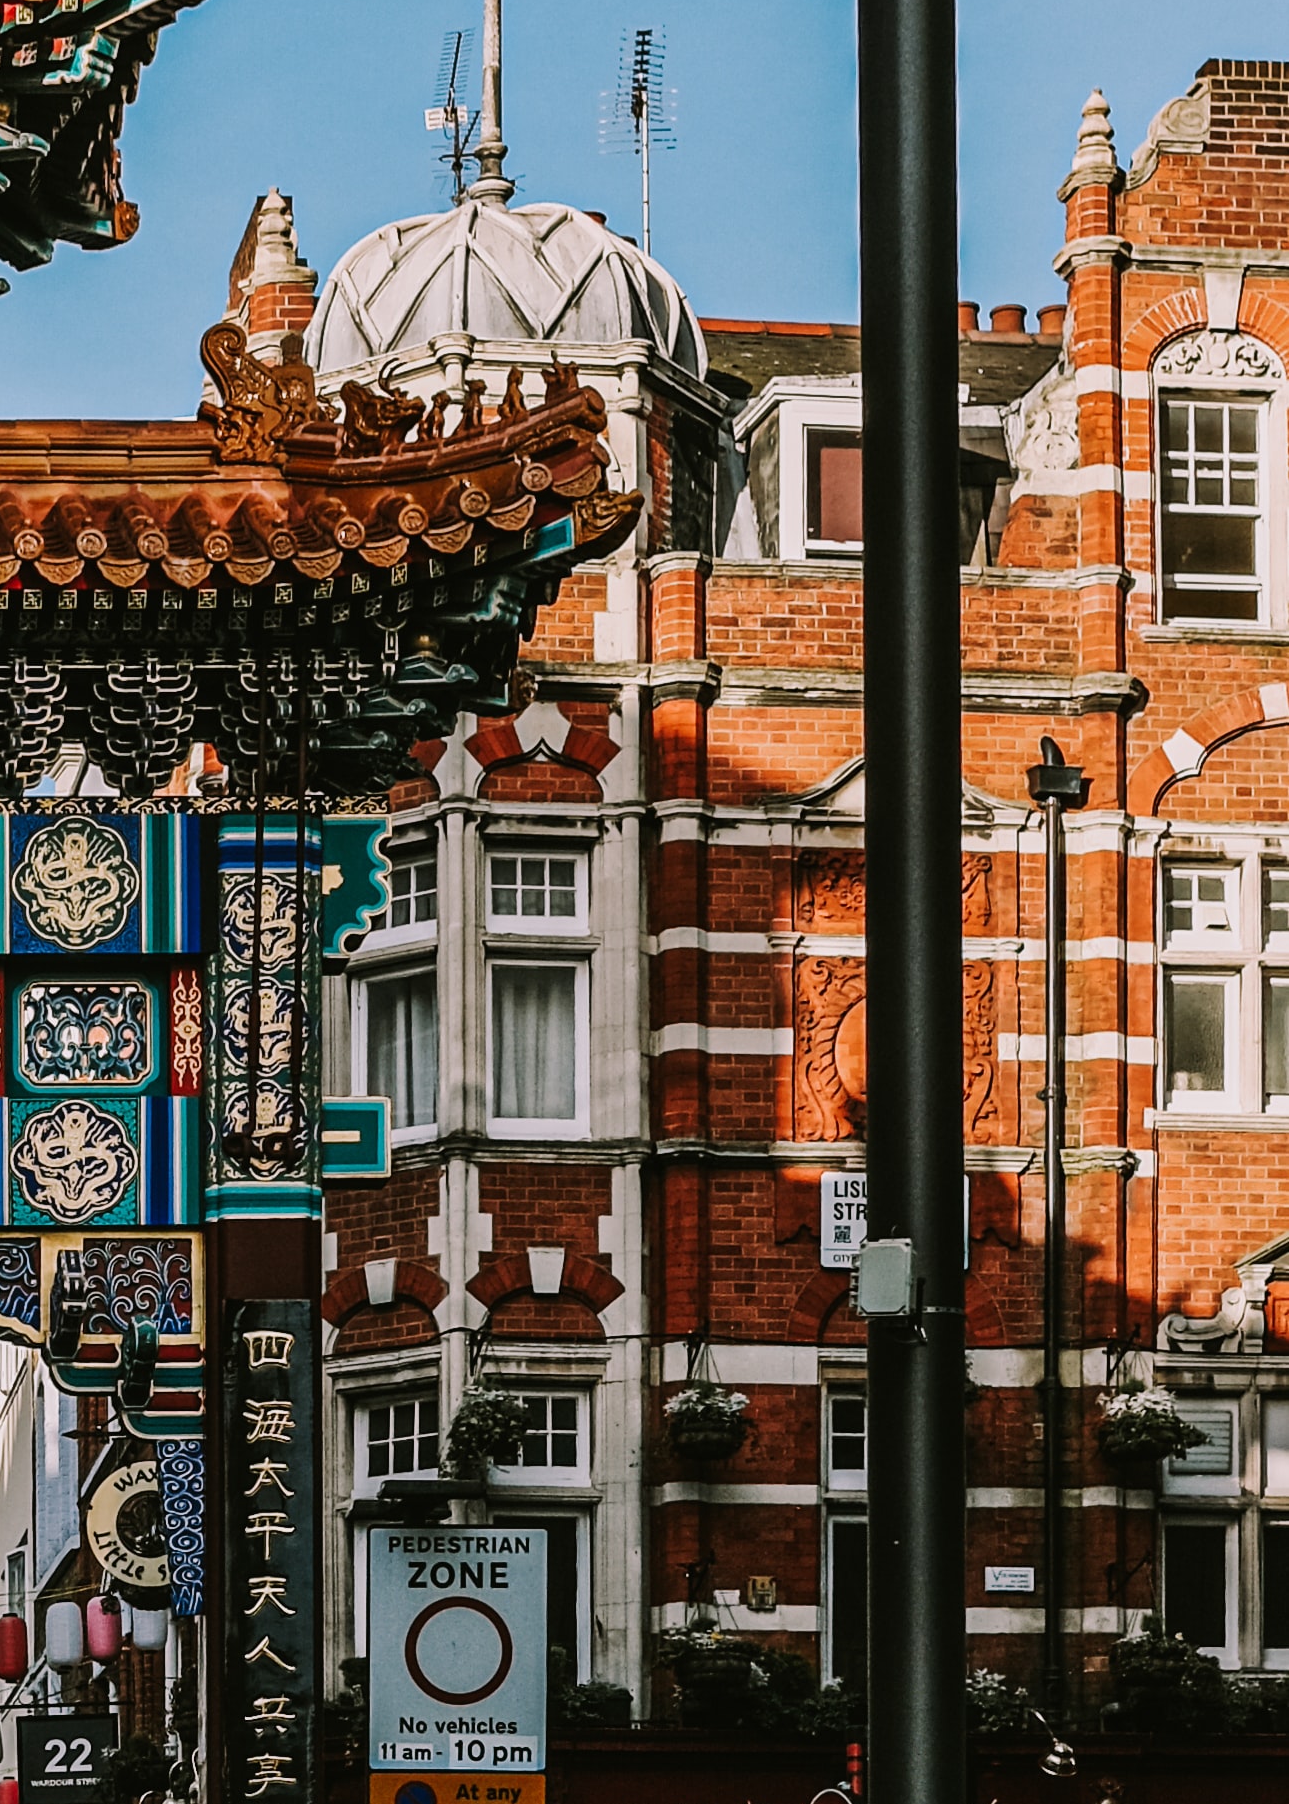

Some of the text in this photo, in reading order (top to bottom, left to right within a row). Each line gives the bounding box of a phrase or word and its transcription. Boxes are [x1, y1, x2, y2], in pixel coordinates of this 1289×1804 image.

[388, 1536, 530, 1554] PEDESTRIAN
[407, 1561, 509, 1589] ZONE
[399, 1716, 518, 1735] No vehicles
[44, 1737, 93, 1773] 22
[380, 1743, 396, 1760] 11
[402, 1746, 432, 1761] am
[454, 1739, 486, 1762] 10
[493, 1745, 533, 1766] pm
[456, 1784, 521, 1804] At any
